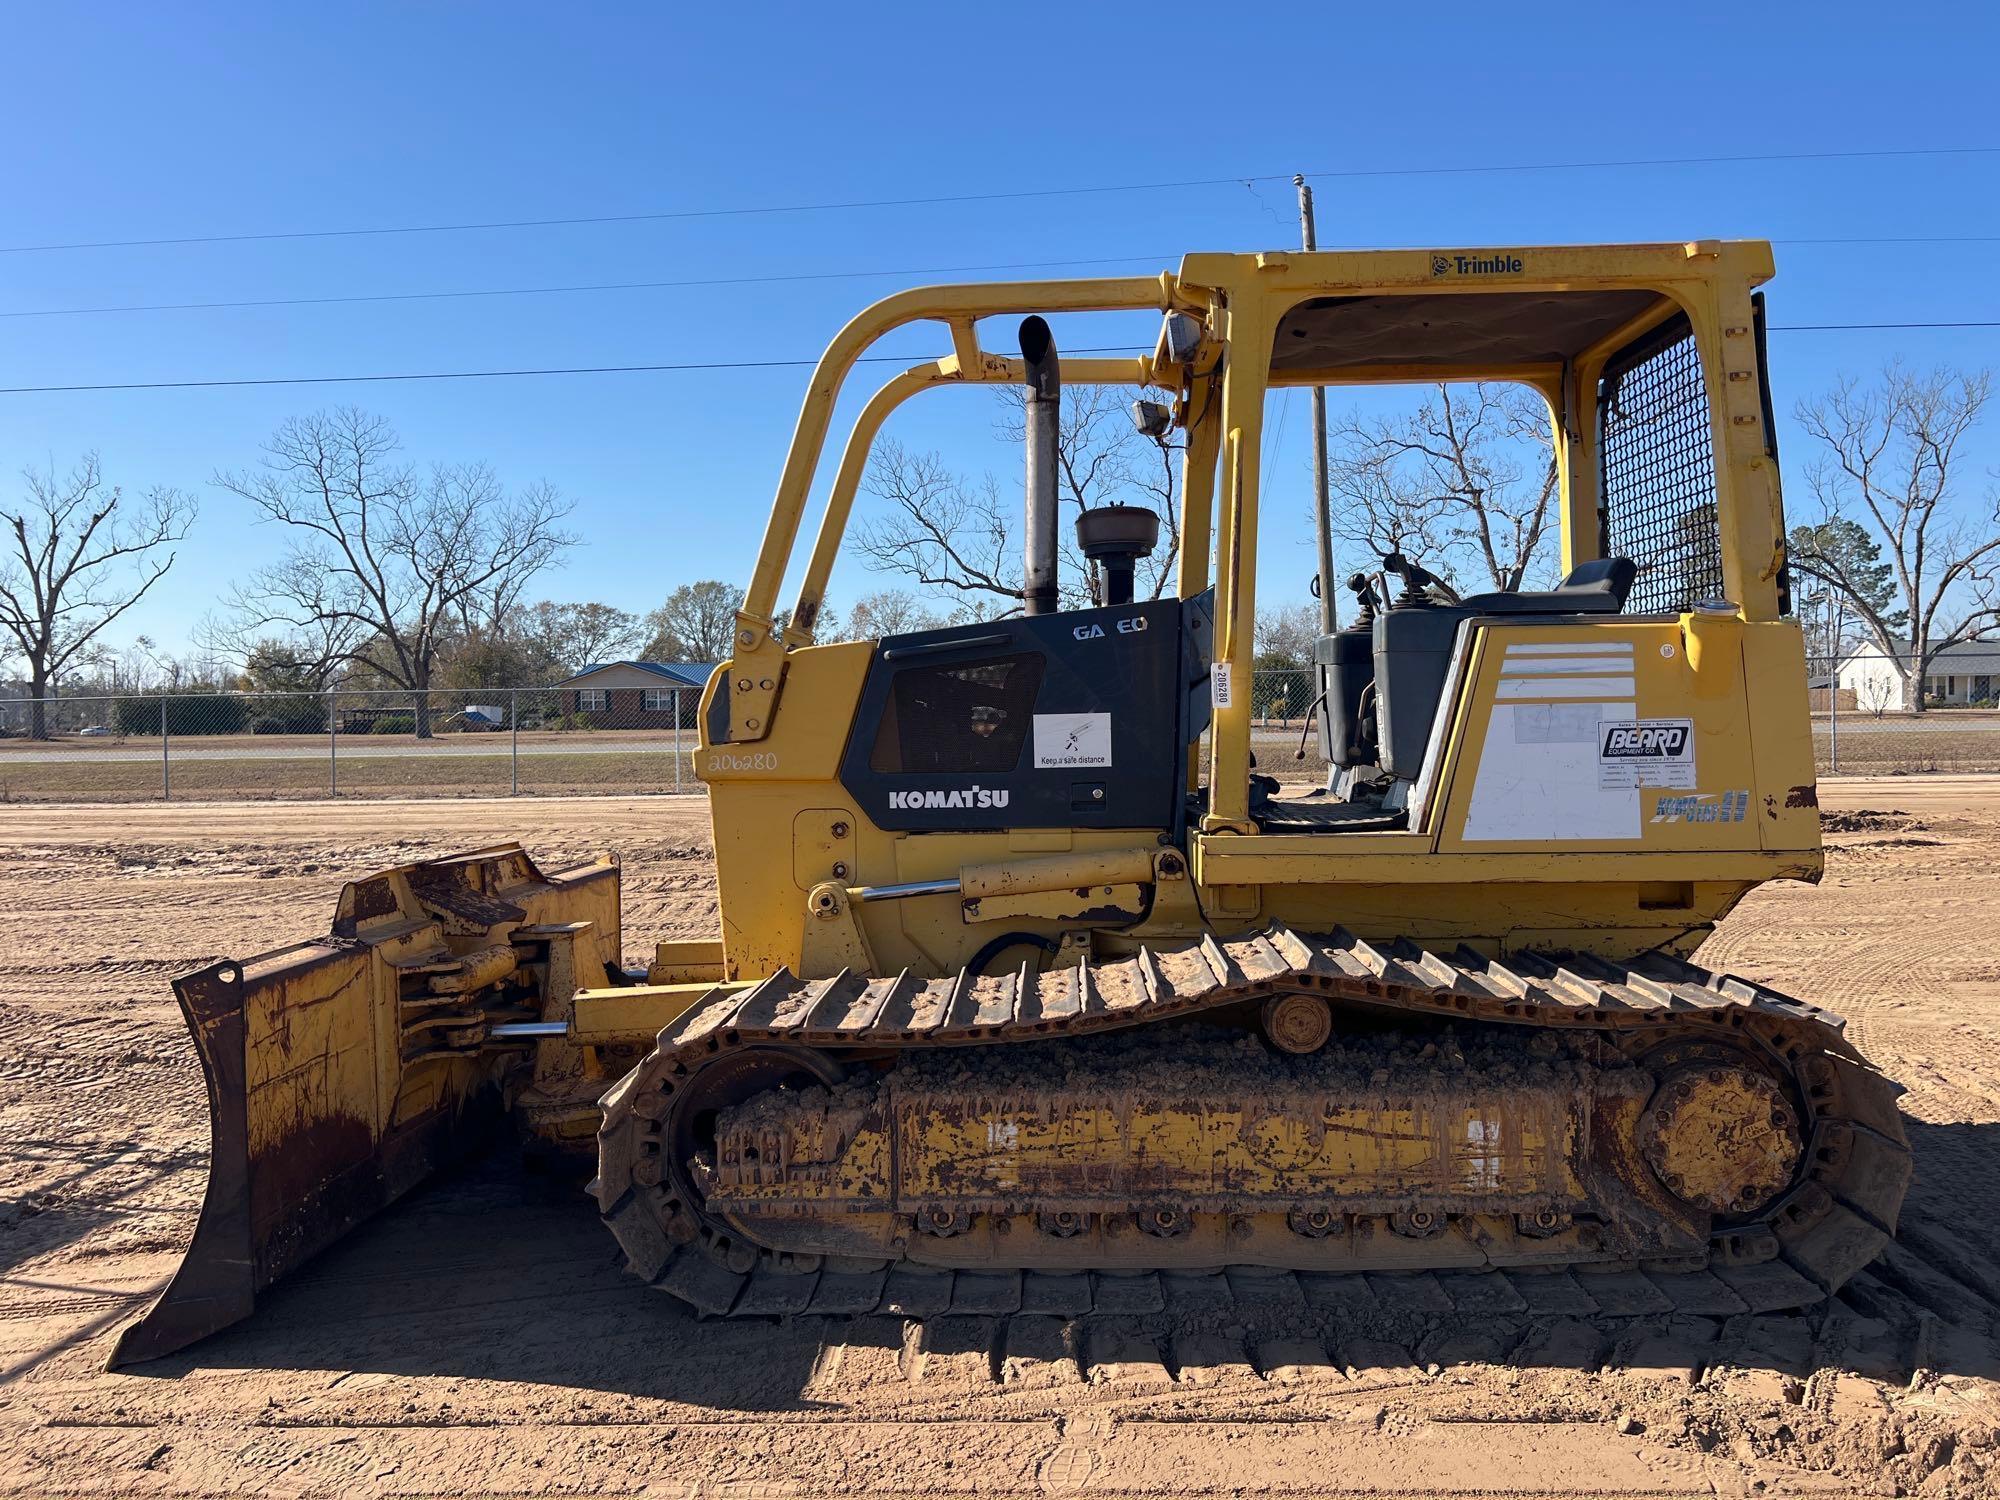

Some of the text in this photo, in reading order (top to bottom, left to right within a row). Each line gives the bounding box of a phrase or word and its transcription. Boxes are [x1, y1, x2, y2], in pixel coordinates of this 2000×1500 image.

[1454, 255, 1522, 274] Trimble
[1217, 672, 1228, 703] 206280
[1609, 729, 1682, 756] BEARD
[708, 752, 778, 771] 206280
[1041, 757, 1057, 766] Keep
[1064, 756, 1077, 764] safe
[1078, 756, 1105, 764] distance
[889, 785, 1009, 809] KOMATSU
